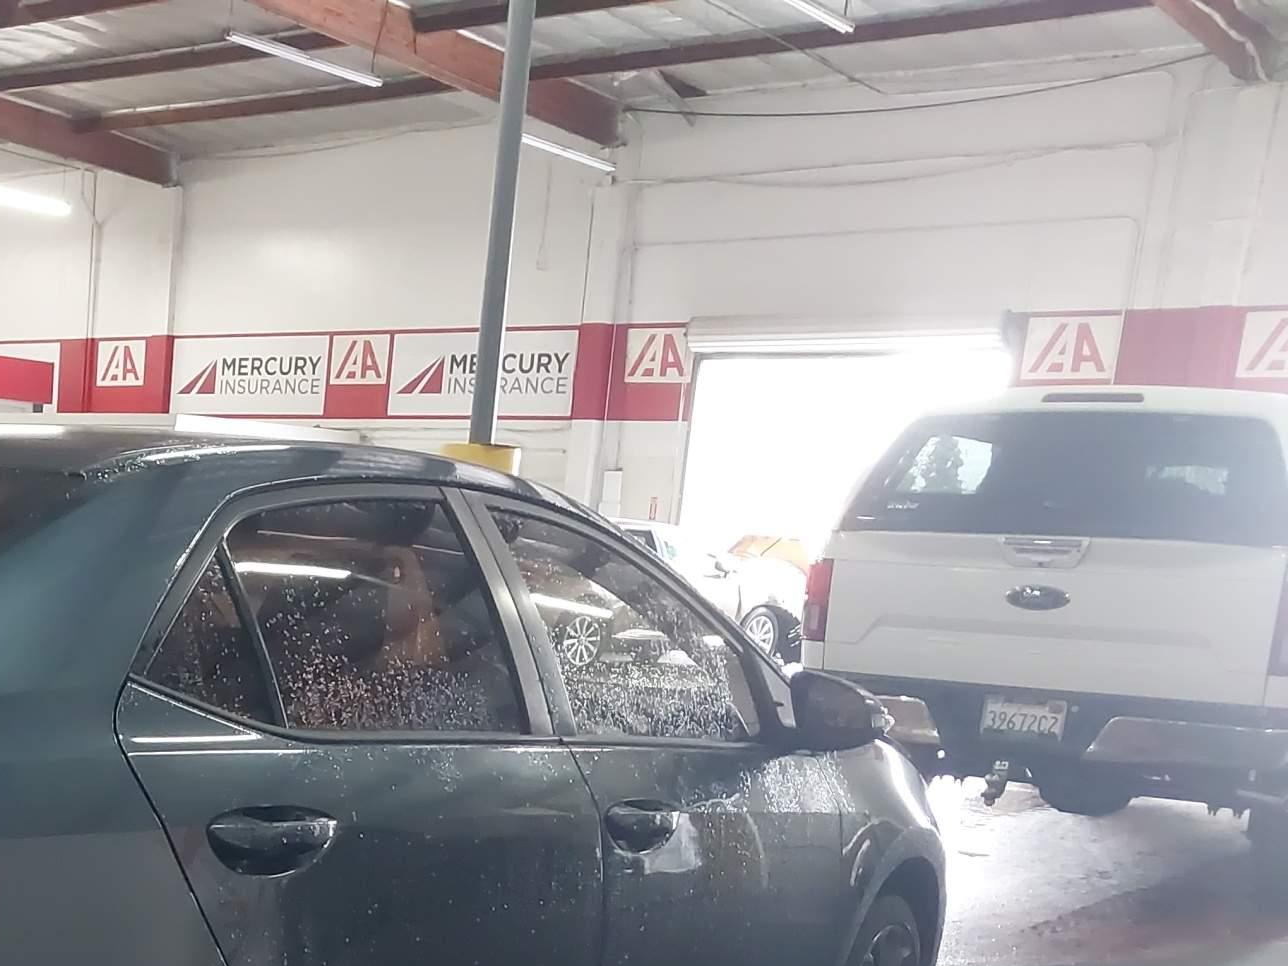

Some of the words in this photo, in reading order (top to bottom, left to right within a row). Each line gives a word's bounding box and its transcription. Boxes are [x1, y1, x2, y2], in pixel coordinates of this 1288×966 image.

[221, 356, 322, 376] MERCURY
[449, 353, 570, 374] MECURY
[219, 378, 321, 395] INSURANCE
[447, 376, 569, 394] INSRANCE
